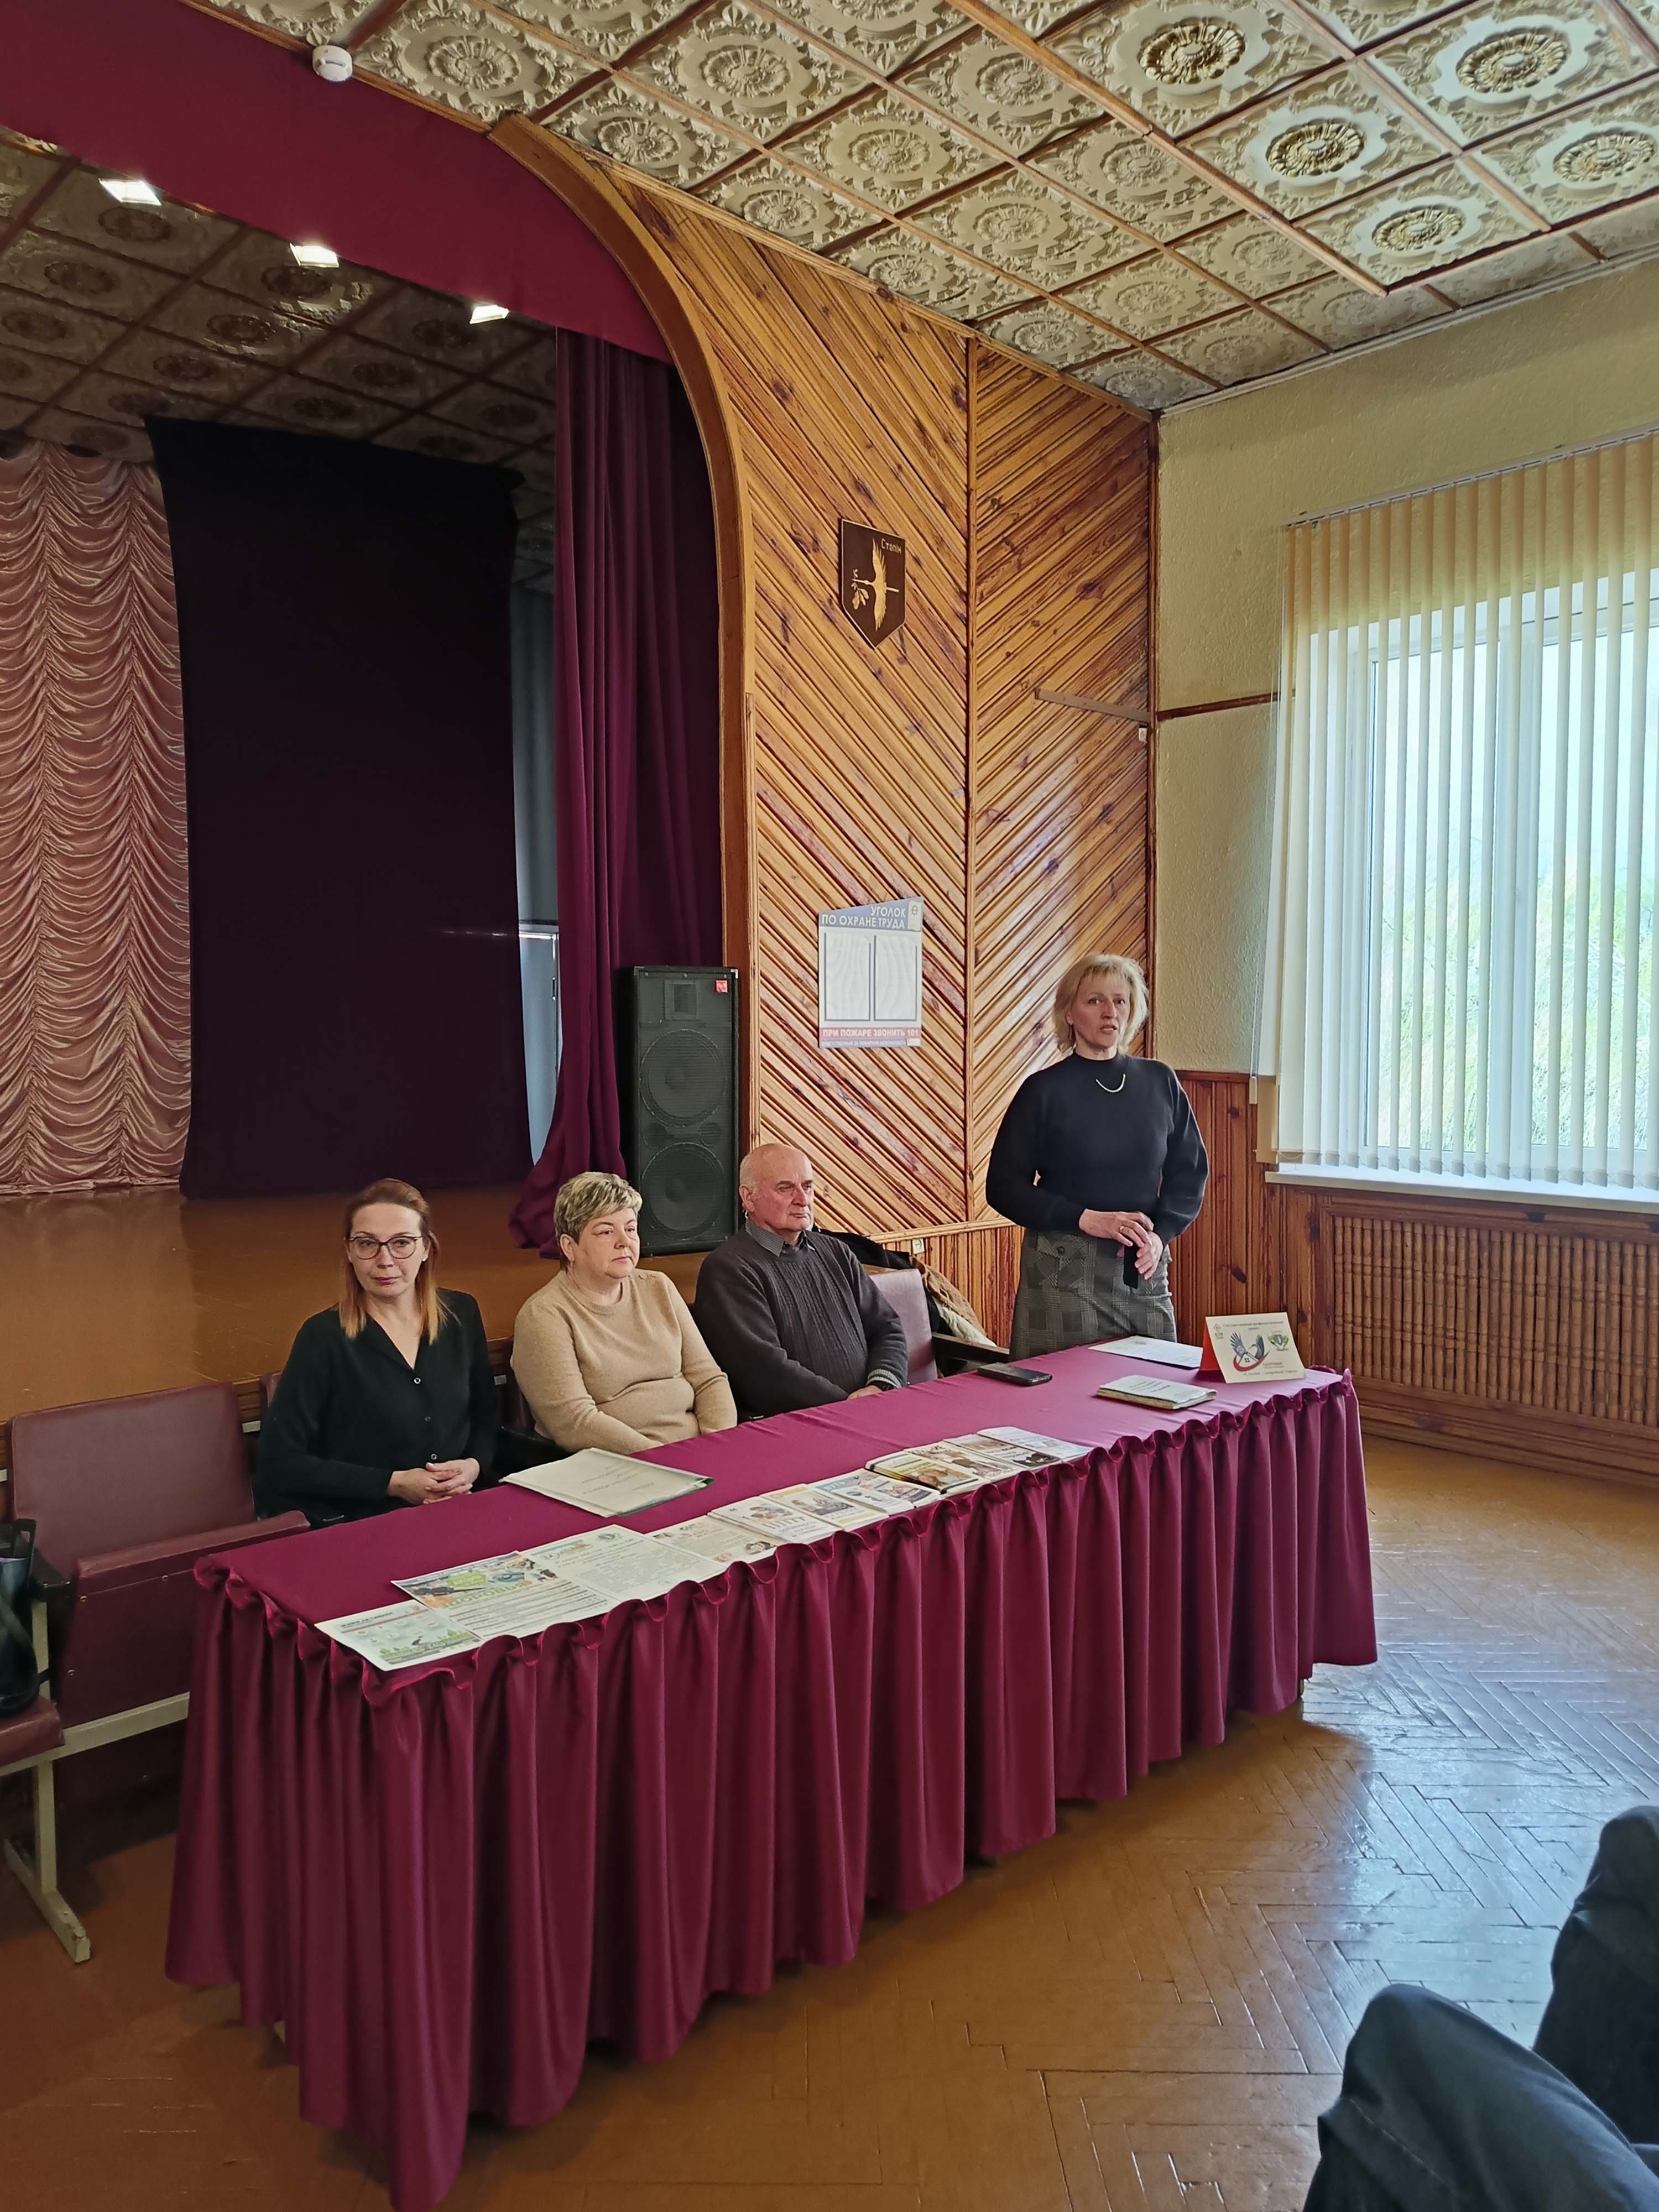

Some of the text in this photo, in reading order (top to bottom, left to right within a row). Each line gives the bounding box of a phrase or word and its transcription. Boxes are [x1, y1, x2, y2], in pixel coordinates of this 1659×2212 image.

[870, 906, 906, 917] УГОЛОК
[822, 915, 905, 929] ПО ОХРАНЕ ТРУДА
